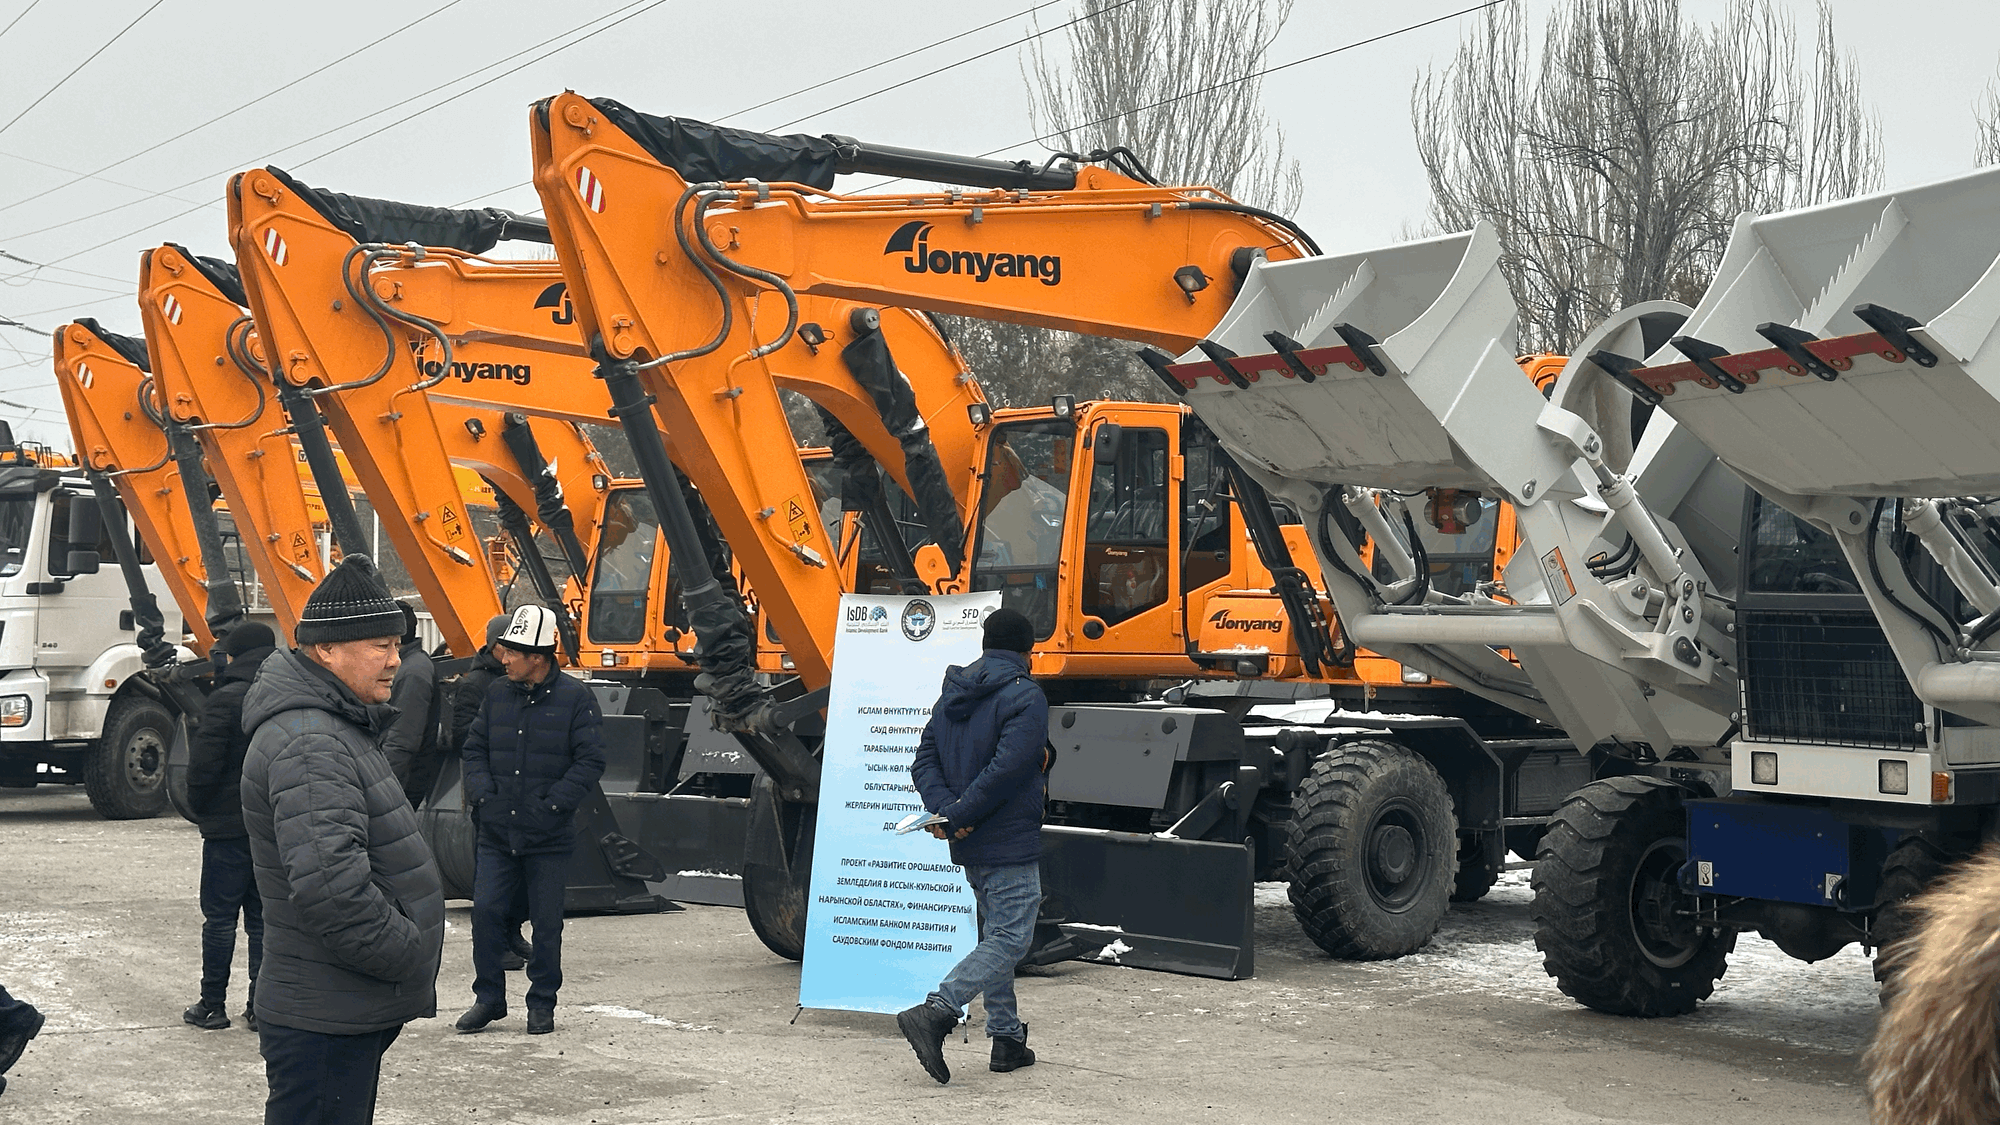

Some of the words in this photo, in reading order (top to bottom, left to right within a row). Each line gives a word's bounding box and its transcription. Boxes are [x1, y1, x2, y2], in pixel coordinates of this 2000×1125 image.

[904, 225, 1061, 286] Jonyang
[846, 606, 868, 621] IsDB
[962, 608, 979, 619] SFD
[1215, 610, 1283, 633] Jonyang
[857, 707, 883, 715] ИСЛАМ
[870, 726, 887, 735] САУД
[863, 744, 902, 753] ТАРАБЫНАН
[844, 801, 881, 810] ЖЕРЛЕРИН
[840, 858, 867, 867] ПРОЕКТ
[867, 859, 907, 870] «РАЗВИТИЕ
[907, 862, 961, 873] ОРОШАЕМОГО
[836, 877, 882, 888] ЗЕМЛЕДЕЛИЯ
[883, 880, 888, 888] В
[889, 880, 955, 893] ИССЫК-КУЛЬСКОЙ
[955, 885, 962, 893] И
[818, 895, 862, 906] НАРЫНСКОЙ
[906, 902, 973, 914] ФИНАНСИРУЕМЫЙ
[833, 916, 879, 927] ИСЛАМСКИМ
[879, 919, 911, 929] БАНКОМ
[911, 923, 949, 933] РАЗВИТИЯ
[950, 925, 957, 933] И
[832, 935, 879, 946] САУДОВСКИМ
[880, 939, 914, 950] ФОНДОМ
[915, 942, 953, 953] РАЗВИТИЯ
